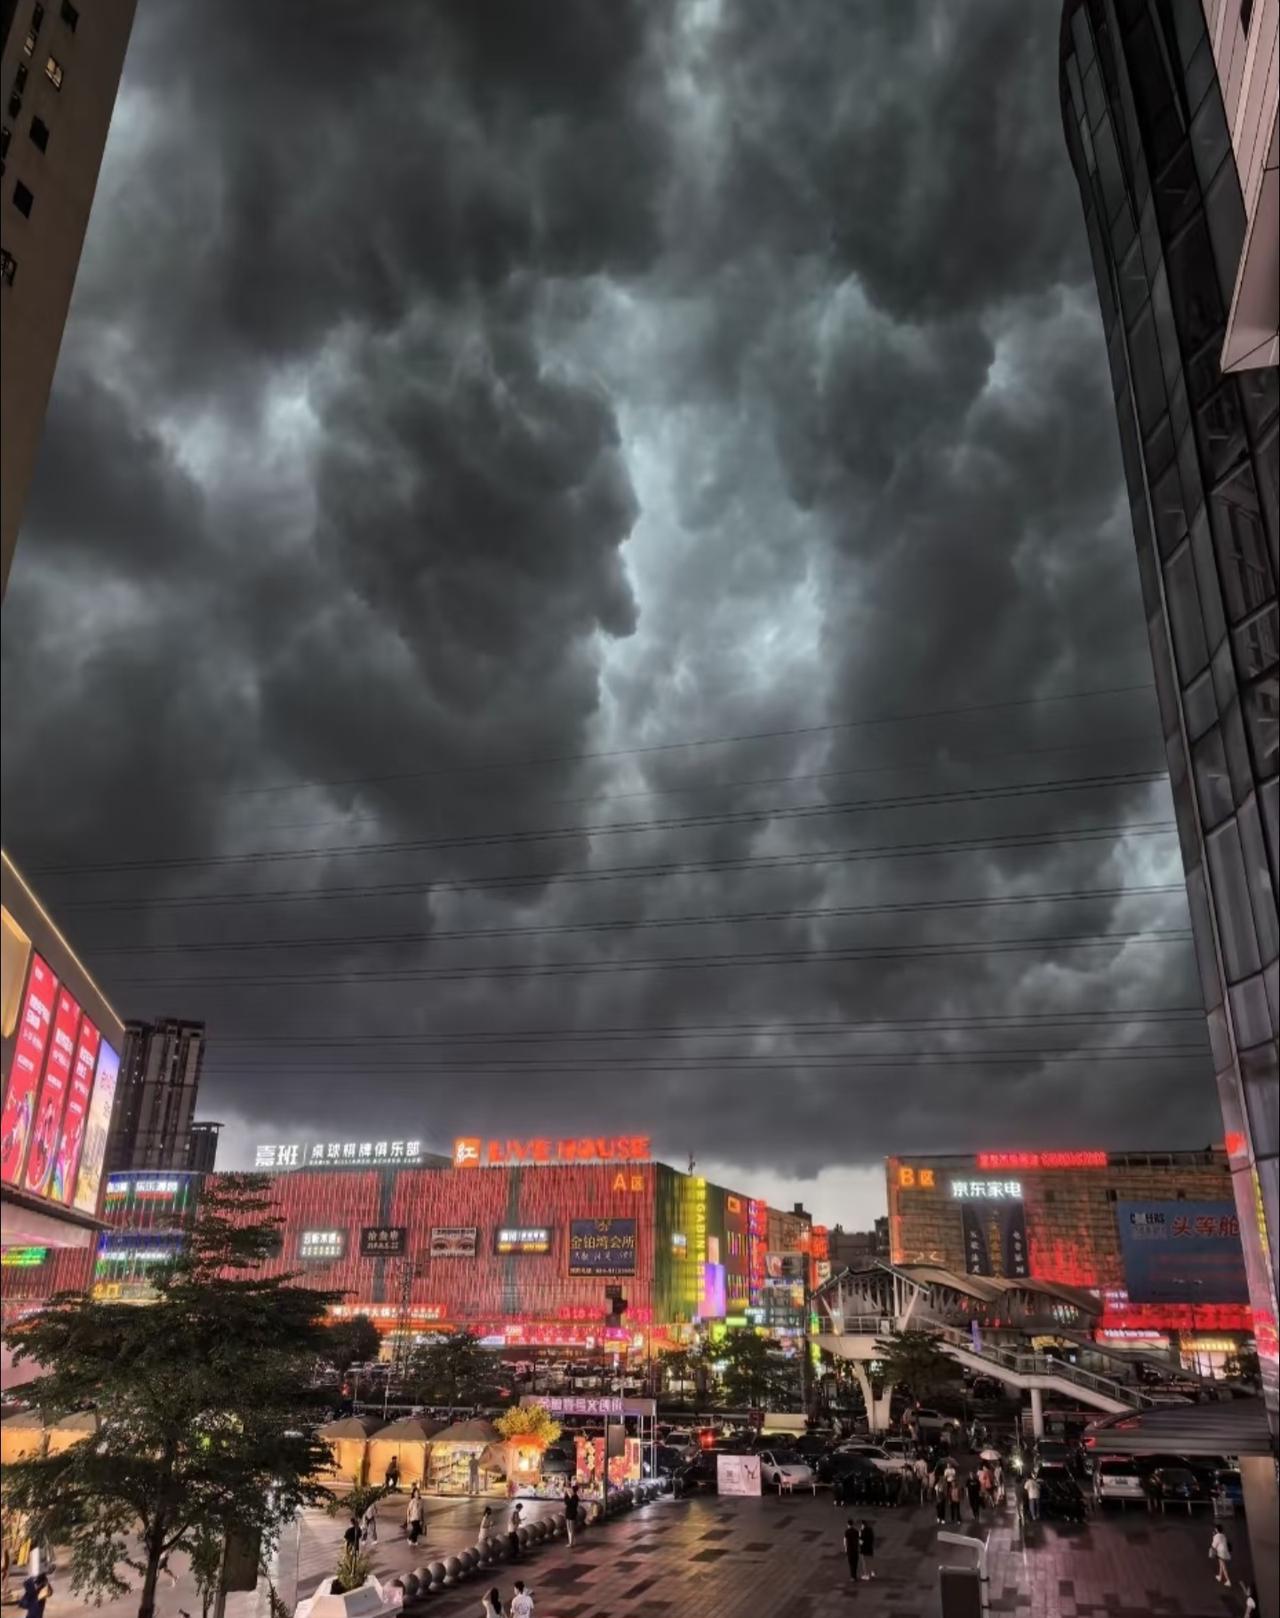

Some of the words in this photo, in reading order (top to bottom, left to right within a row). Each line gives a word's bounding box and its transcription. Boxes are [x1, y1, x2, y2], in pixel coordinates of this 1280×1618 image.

[312, 1141, 420, 1159] 桌球棋牌俱乐部
[488, 1138, 550, 1161] LIVE
[558, 1135, 650, 1160] HOUSE
[952, 1181, 1022, 1198] 京东家电
[1171, 1215, 1240, 1238] 头等舱
